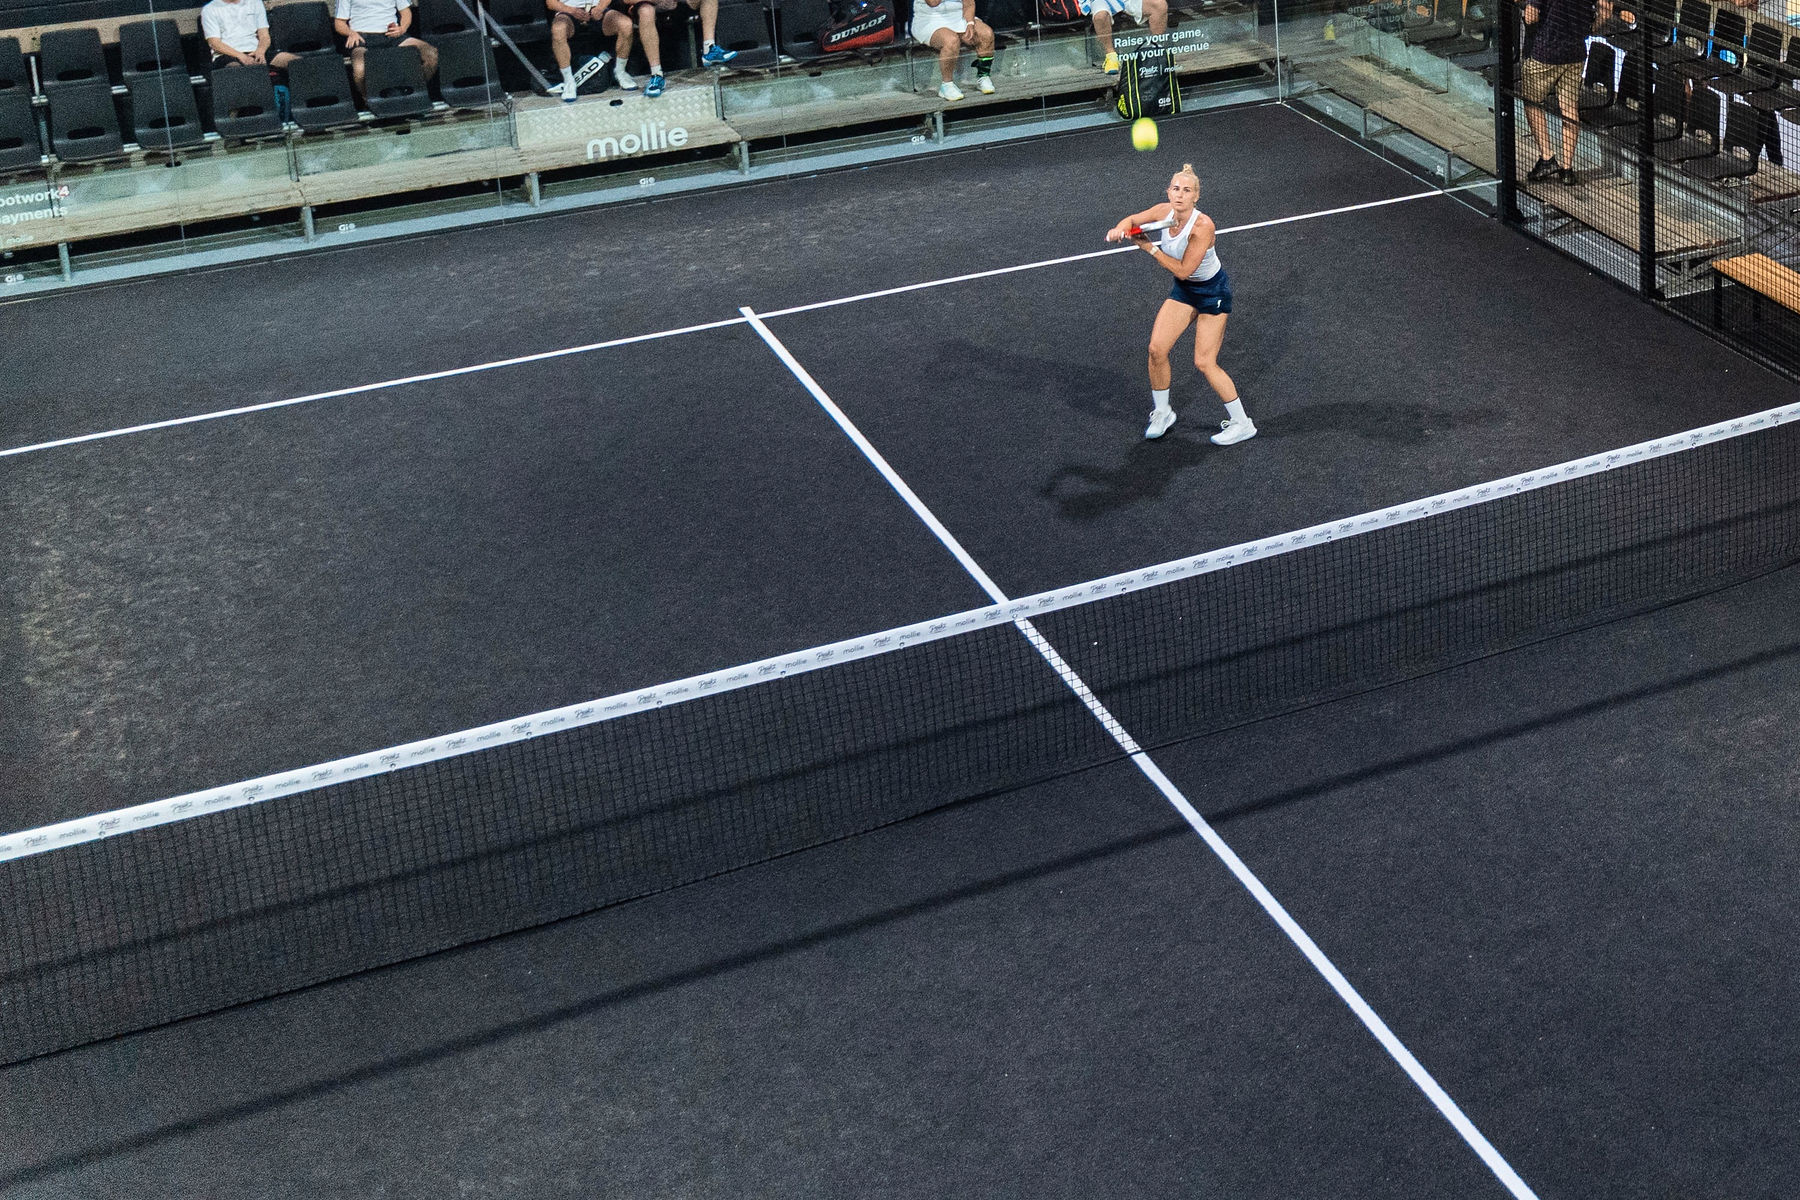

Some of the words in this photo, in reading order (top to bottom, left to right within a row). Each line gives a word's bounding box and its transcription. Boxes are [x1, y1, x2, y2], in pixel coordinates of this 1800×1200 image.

[830, 14, 887, 43] DUNLOP
[1114, 36, 1143, 48] Raise
[1145, 33, 1169, 45] your
[1172, 29, 1204, 42] game,
[1114, 51, 1139, 62] row
[1141, 49, 1166, 61] your
[1167, 42, 1210, 55] revenue
[568, 62, 599, 87] EAD
[587, 121, 689, 159] mollie
[0, 206, 68, 225] ayments
[0, 843, 11, 852] lie
